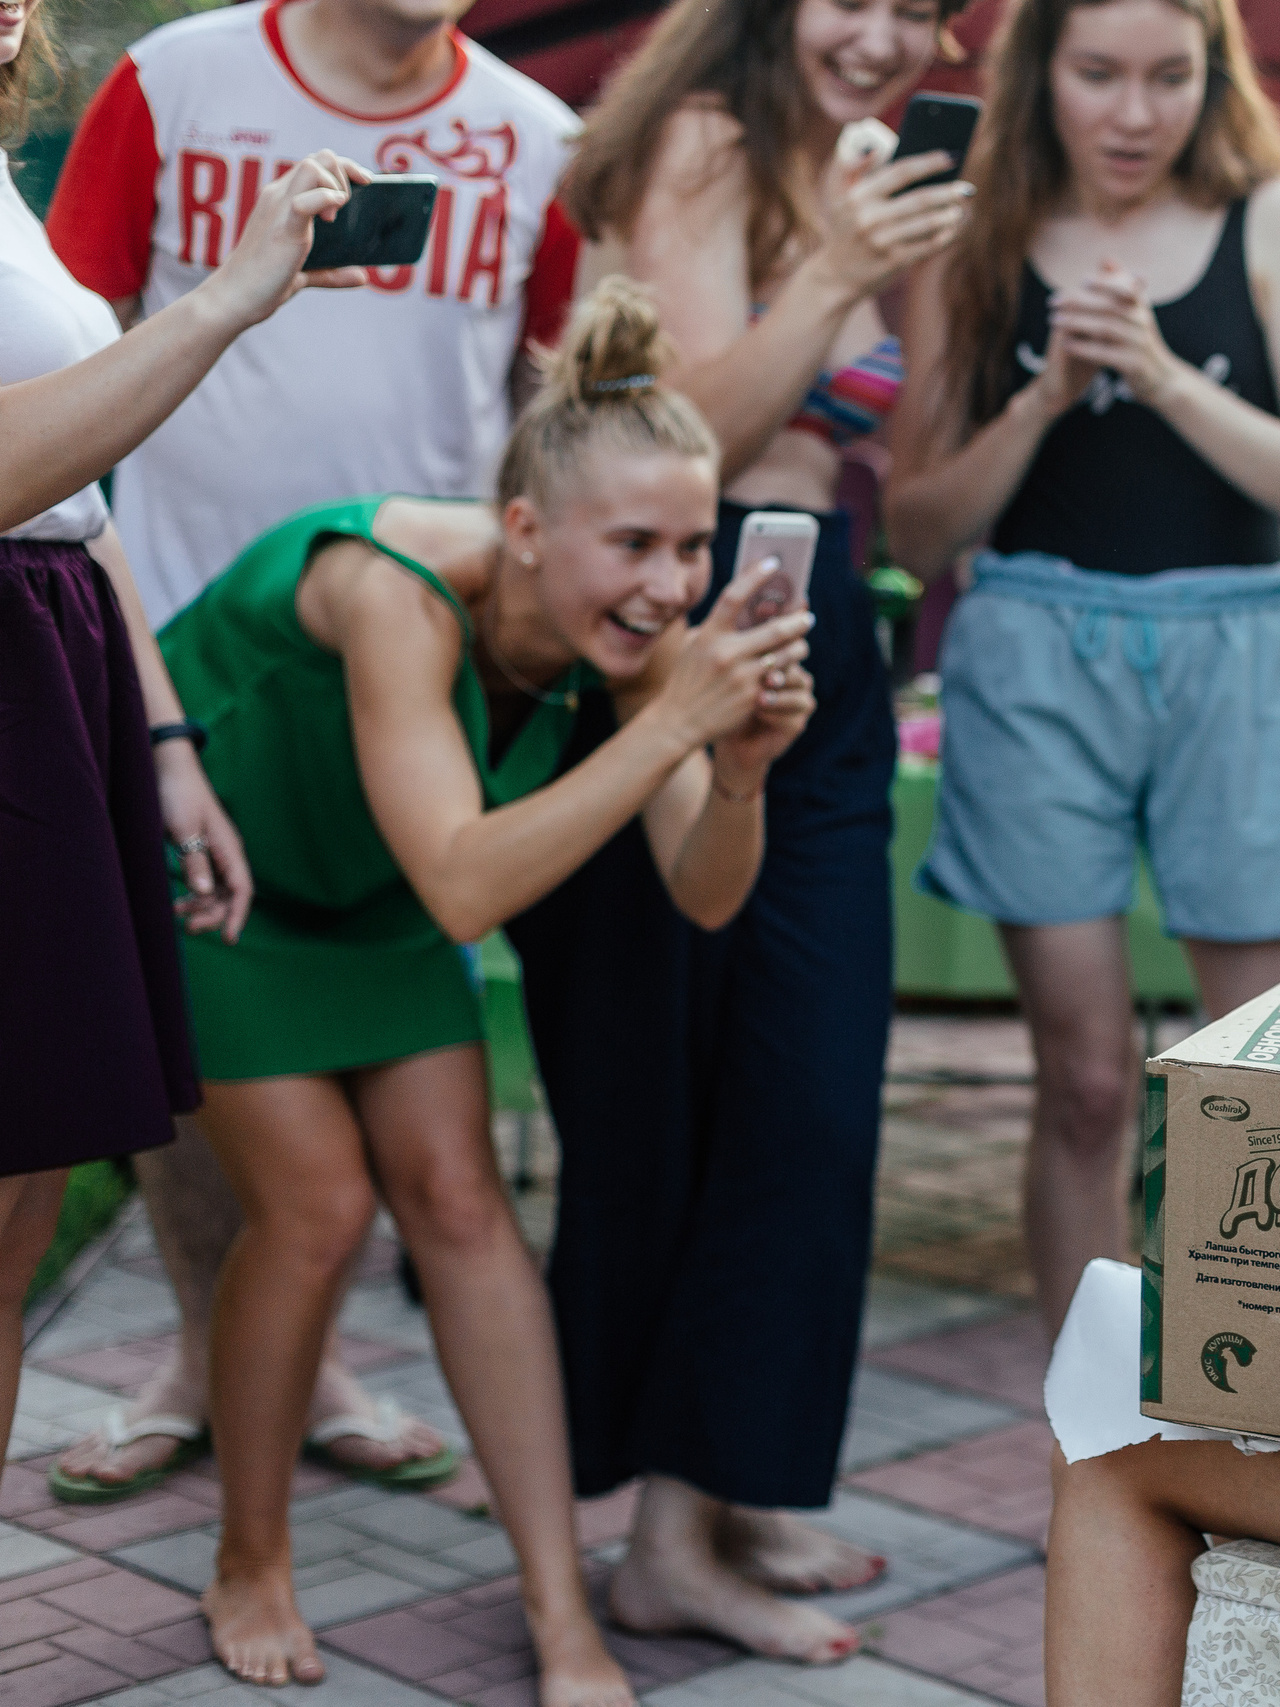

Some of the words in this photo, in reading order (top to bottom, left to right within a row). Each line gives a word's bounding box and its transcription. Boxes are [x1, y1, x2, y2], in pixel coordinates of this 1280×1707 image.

[1208, 1102, 1243, 1114] Doshirak
[1205, 1240, 1237, 1254] Лапша
[1188, 1249, 1229, 1263] Хранить
[1230, 1256, 1249, 1267] при
[1196, 1272, 1219, 1284] Дата
[1207, 1335, 1244, 1352] КУРИЦЫ
[1204, 1358, 1219, 1382] ВКУС
